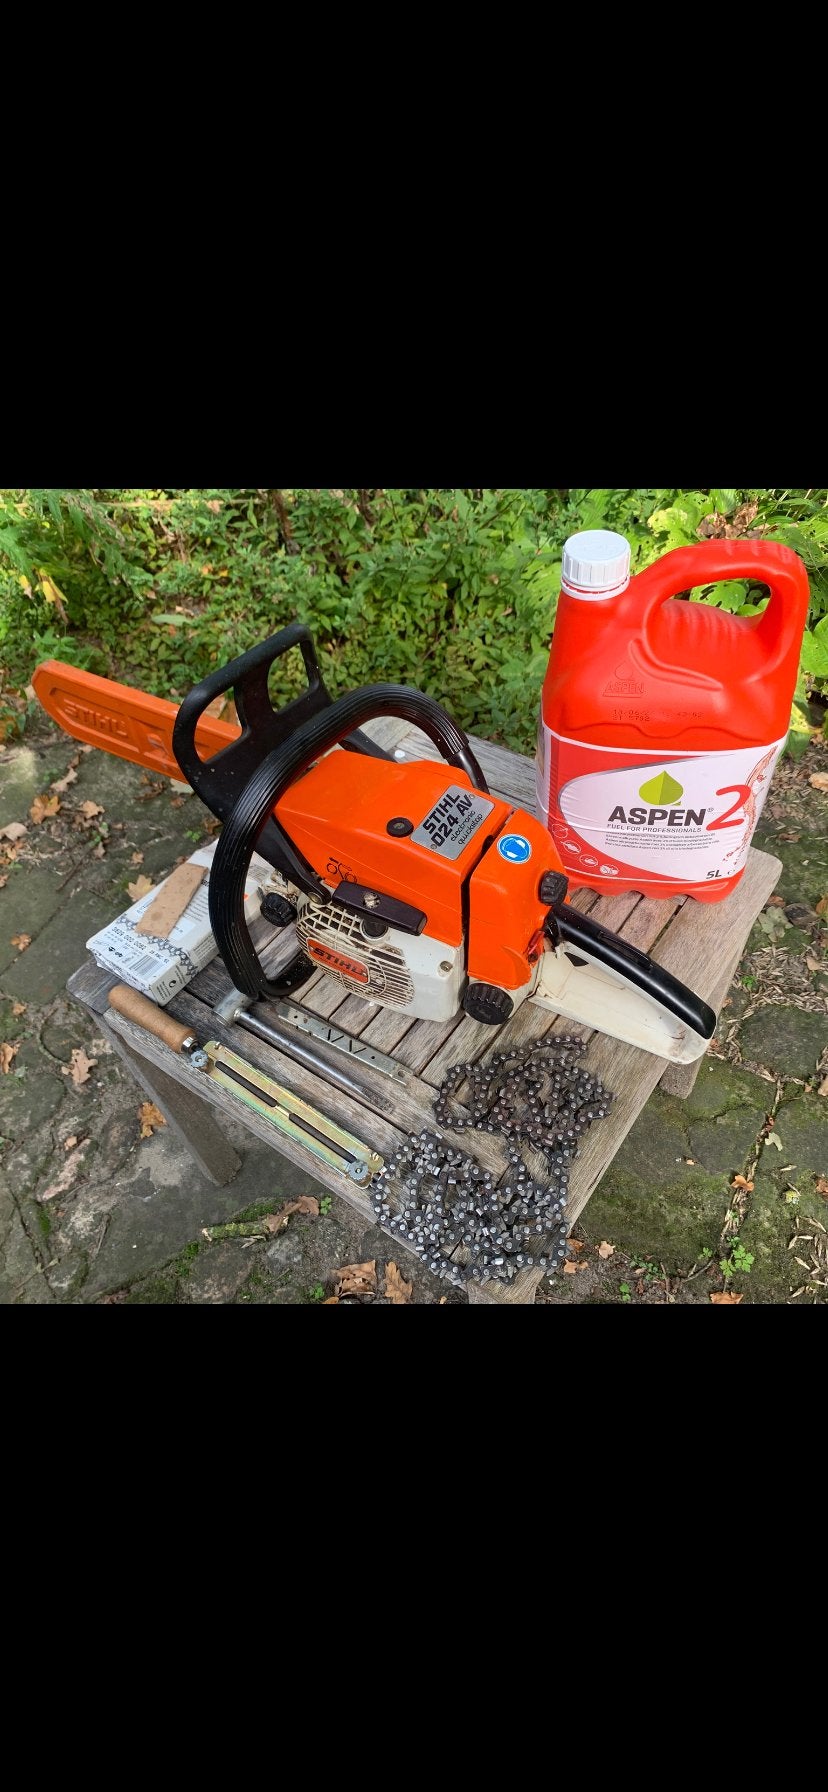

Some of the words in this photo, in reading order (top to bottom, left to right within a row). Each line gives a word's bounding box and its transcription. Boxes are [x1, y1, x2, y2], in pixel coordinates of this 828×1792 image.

[605, 681, 645, 694] ASPEN
[63, 699, 128, 736] STIHL
[422, 793, 461, 835] STIHL
[431, 814, 459, 846] 024
[456, 794, 472, 816] AV
[608, 805, 706, 827] ASPEN
[706, 784, 751, 831] 2
[450, 810, 476, 842] electronic
[458, 813, 483, 845] quickstop
[606, 823, 625, 831] FUEL
[705, 869, 723, 879] 5L
[313, 948, 363, 974] STIHL
